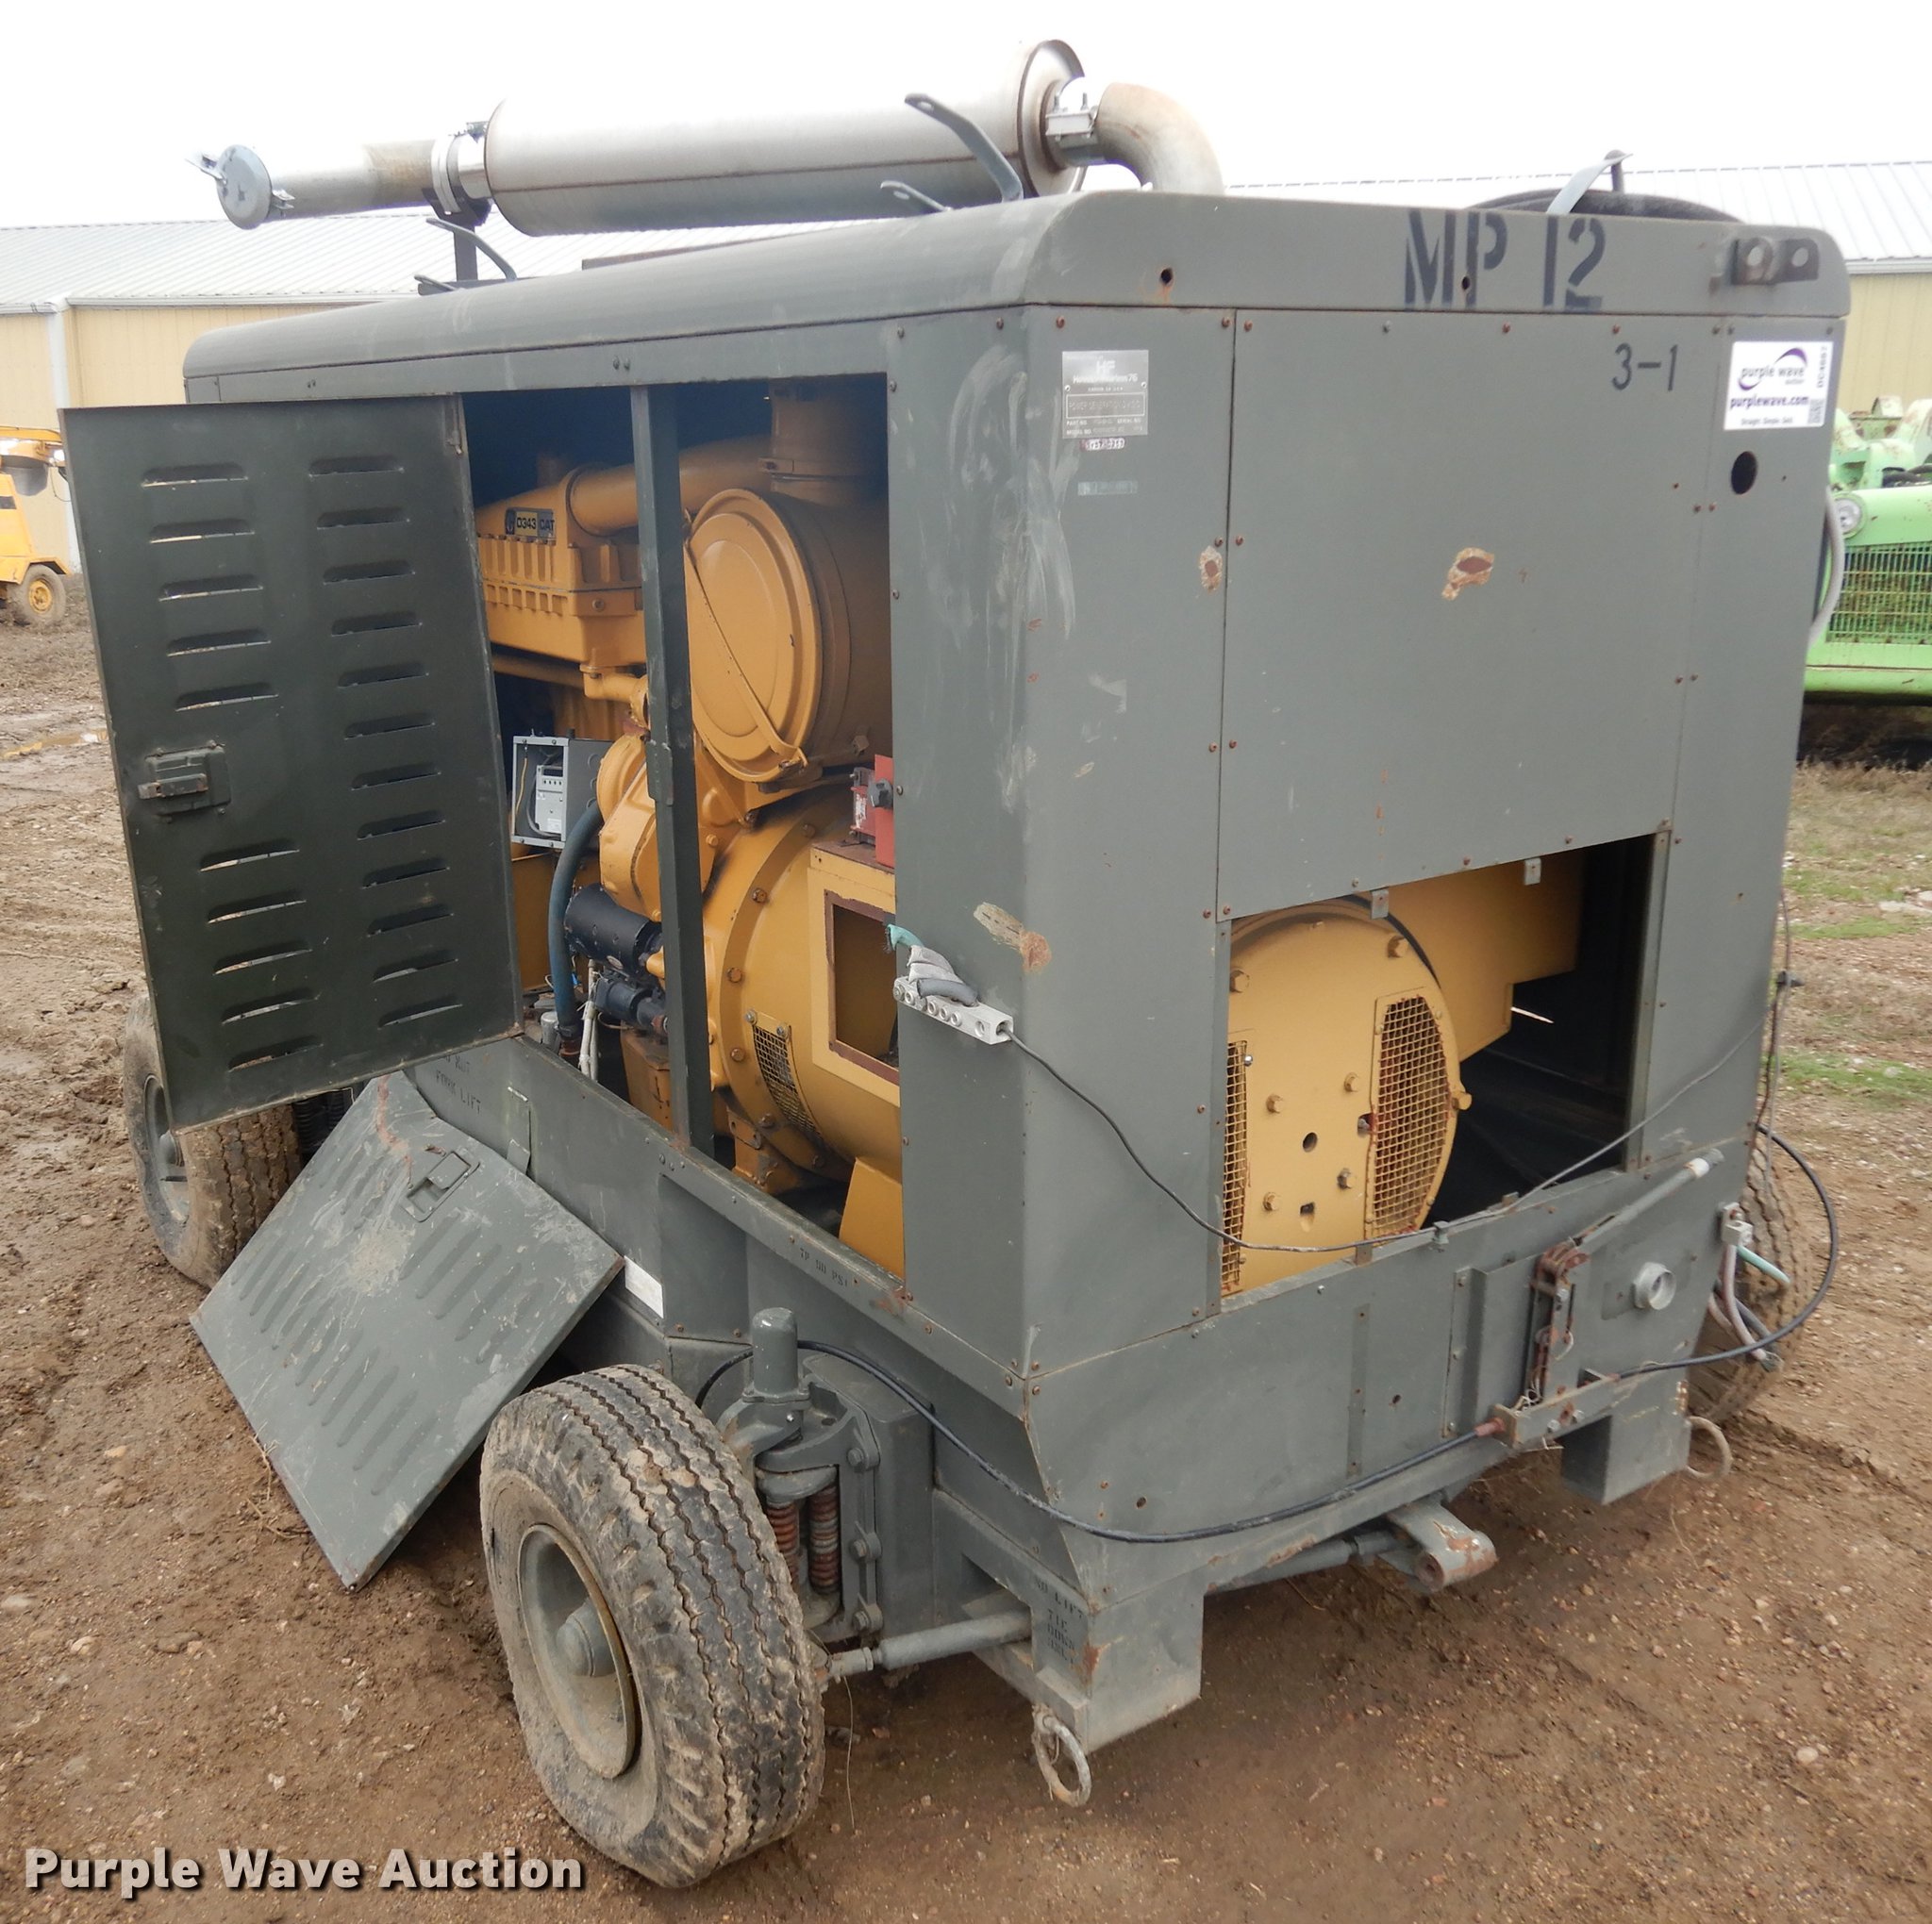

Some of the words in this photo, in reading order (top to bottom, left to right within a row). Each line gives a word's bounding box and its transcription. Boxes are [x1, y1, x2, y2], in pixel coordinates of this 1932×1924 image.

[1405, 208, 1507, 307] MP
[1543, 215, 1606, 307] 12
[1611, 342, 1678, 391] 3-1
[1741, 365, 1774, 379] purple
[1778, 367, 1805, 377] wave
[1729, 393, 1809, 410] purplewave.com
[516, 516, 537, 530] D343
[540, 519, 555, 532] CAT
[459, 1088, 481, 1115] LIFT
[832, 1269, 848, 1286] PSI
